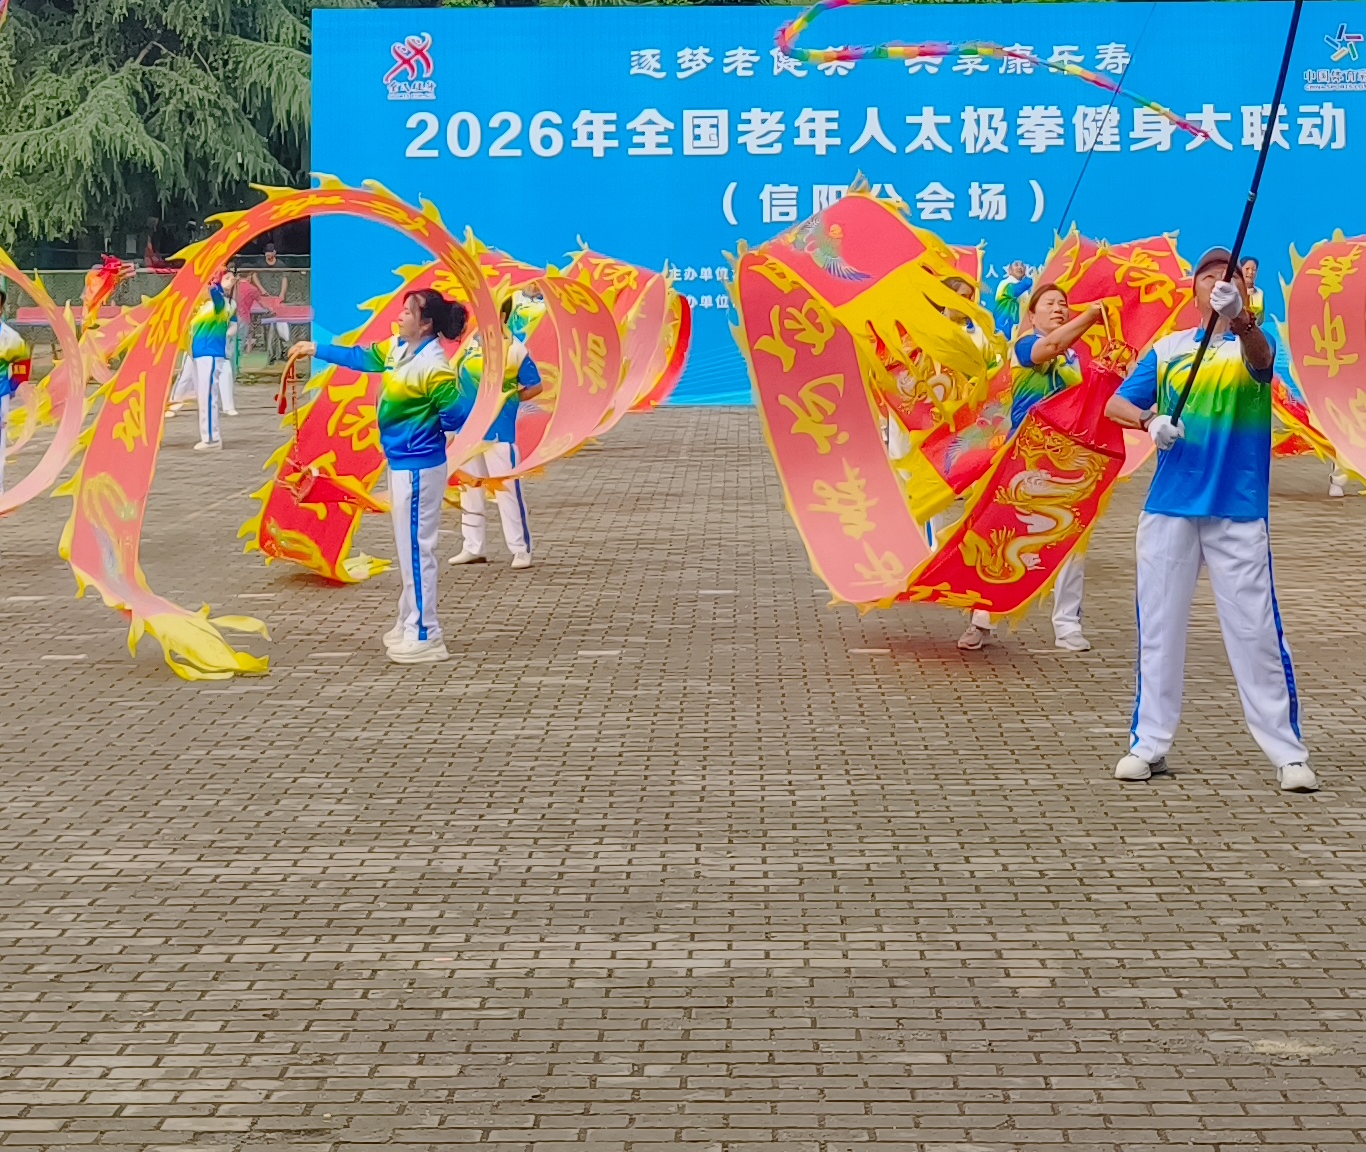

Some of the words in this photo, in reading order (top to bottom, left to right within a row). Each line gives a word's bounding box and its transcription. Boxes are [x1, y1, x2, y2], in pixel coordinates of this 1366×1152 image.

[404, 101, 1347, 158] 2026年全国老年人太极拳健身大联动
